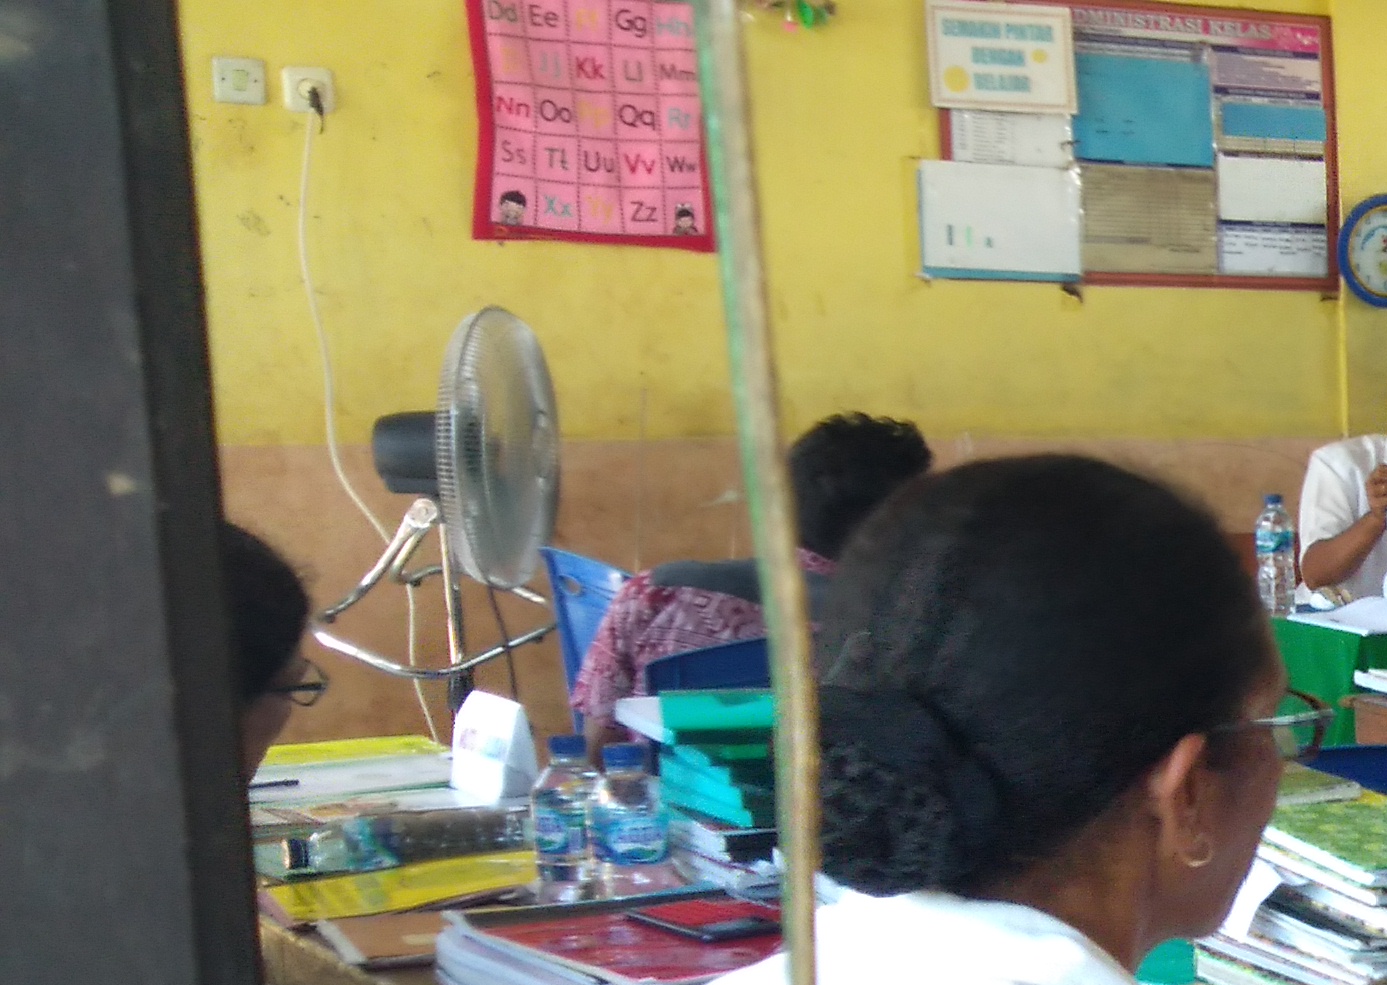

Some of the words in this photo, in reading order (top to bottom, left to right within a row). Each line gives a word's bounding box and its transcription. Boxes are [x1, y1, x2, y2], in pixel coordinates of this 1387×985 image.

[529, 4, 559, 27] Ee
[615, 9, 647, 39] Gg
[1073, 9, 1202, 35] DMINISTRASI
[1209, 19, 1272, 41] KELAS
[575, 57, 605, 80] Kk
[496, 96, 530, 118] Nn
[539, 99, 573, 123] Oo
[618, 104, 656, 131] Qq
[501, 140, 527, 165] Ss
[545, 148, 569, 171] Tt
[583, 151, 616, 173] Uu
[624, 154, 655, 175] Vv
[666, 156, 696, 173] Ww
[544, 194, 573, 218] Xx
[630, 201, 658, 223] Zz
